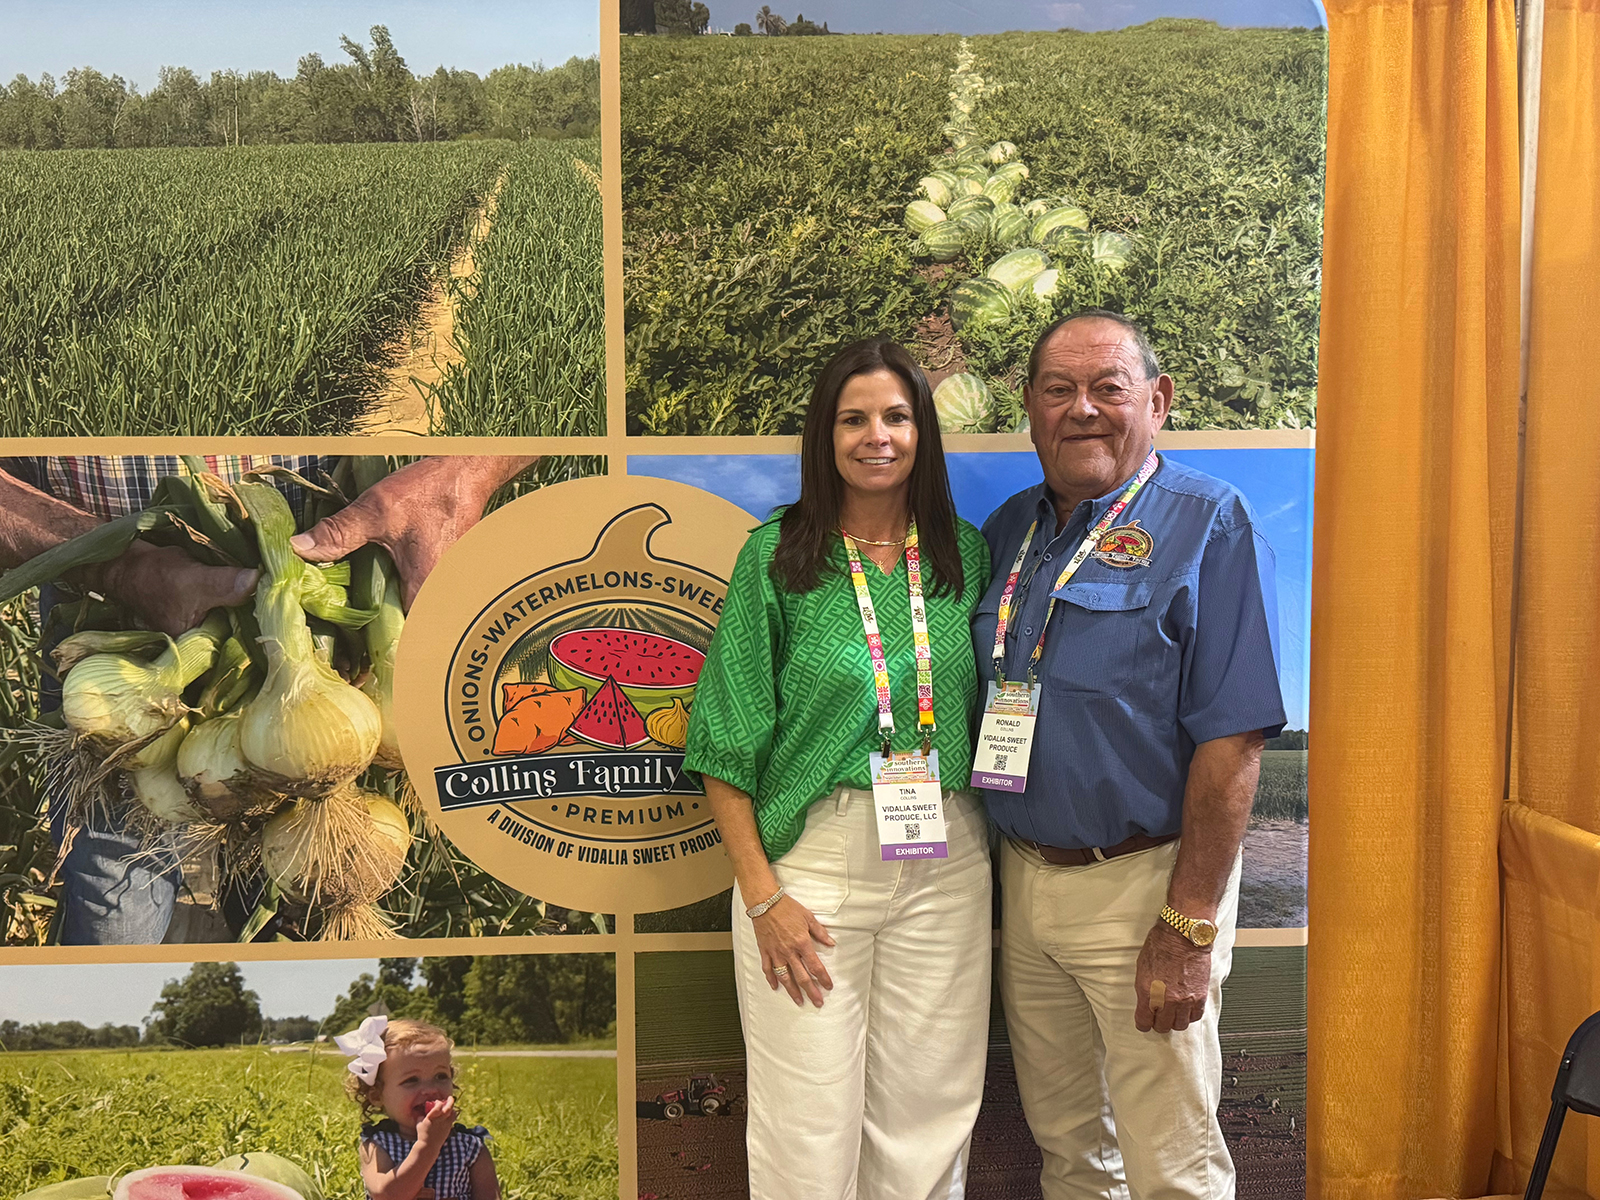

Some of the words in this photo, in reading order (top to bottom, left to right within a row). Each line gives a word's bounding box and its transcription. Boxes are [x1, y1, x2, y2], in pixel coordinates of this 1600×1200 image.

[995, 719, 1020, 727] RONALD
[983, 734, 1006, 743] VIDALIA
[1007, 736, 1027, 745] SWEET
[989, 744, 1018, 753] PRODUCE
[445, 764, 557, 798] Collins
[569, 758, 683, 794] Family
[982, 776, 1013, 787] EXHIBITOR
[565, 801, 685, 825] PREMIUM
[882, 804, 911, 813] VIDALIA
[884, 813, 922, 822] PRODUCE,
[923, 812, 938, 820] LLC
[487, 808, 501, 824] A
[498, 815, 555, 853] DIVISION
[556, 841, 575, 860] OF
[577, 845, 629, 866] VIDALIA
[632, 843, 677, 865] SWEET
[679, 828, 722, 857] PRODU
[895, 847, 934, 856] EXHIBITOR
